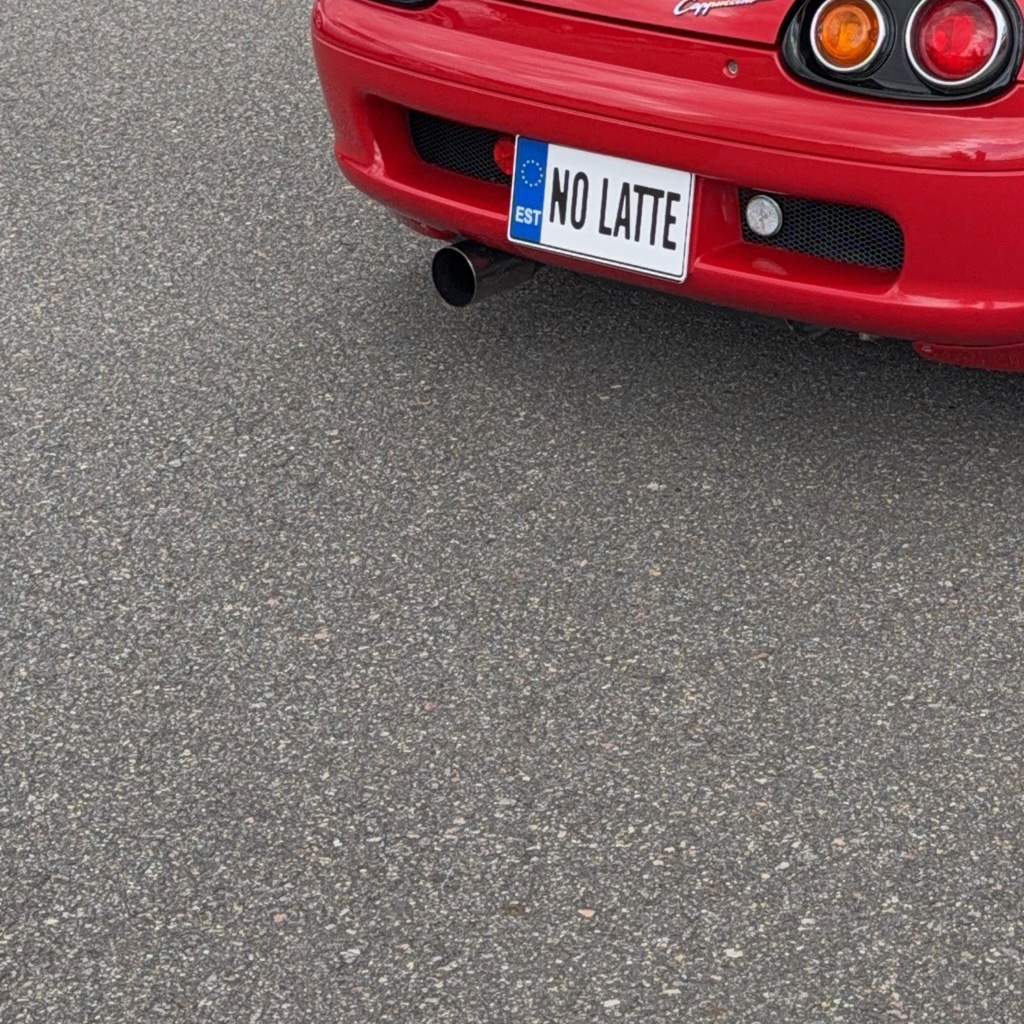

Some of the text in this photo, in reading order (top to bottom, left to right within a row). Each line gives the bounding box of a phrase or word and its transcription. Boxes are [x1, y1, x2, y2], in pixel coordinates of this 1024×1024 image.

[514, 205, 542, 226] EST
[549, 166, 681, 251] NO LATTE
